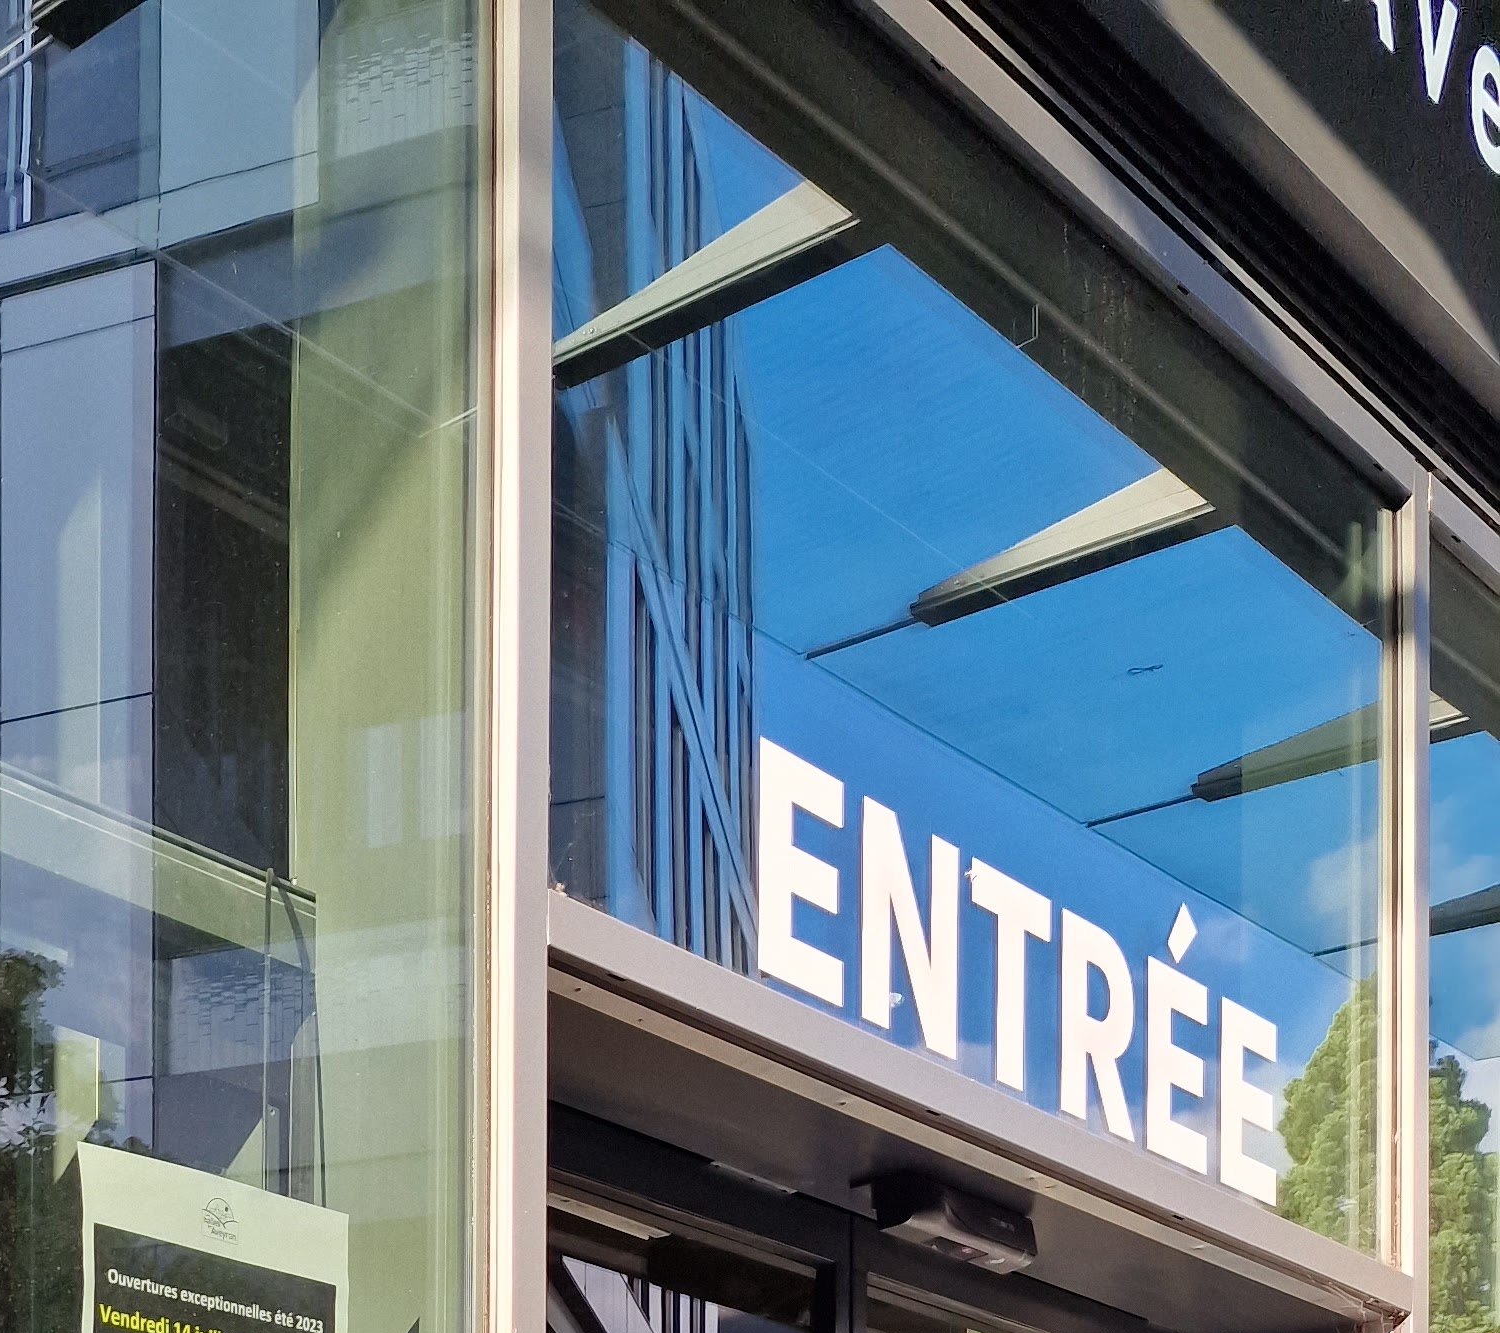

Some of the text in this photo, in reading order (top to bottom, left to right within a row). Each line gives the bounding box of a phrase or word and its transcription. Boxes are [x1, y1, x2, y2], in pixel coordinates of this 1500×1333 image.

[758, 737, 1277, 1207] ENTRÉE
[108, 1269, 323, 1333] Ouvertures exceptionnelles été 2023
